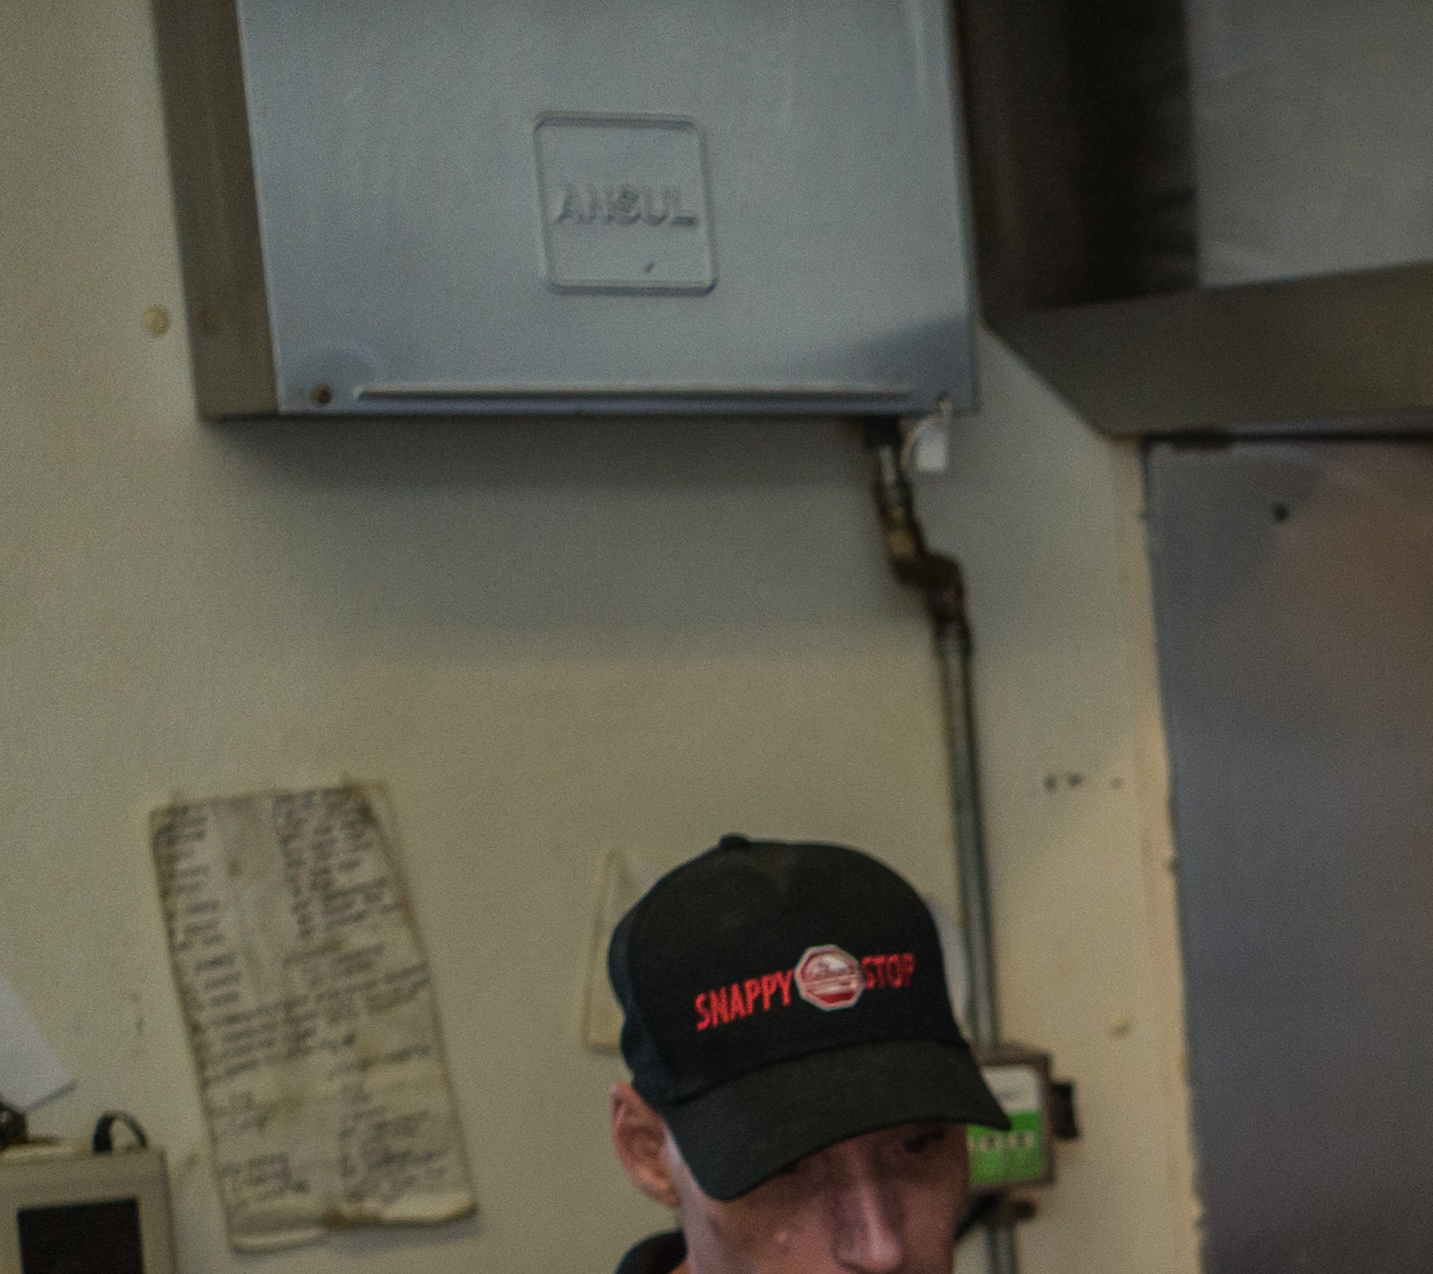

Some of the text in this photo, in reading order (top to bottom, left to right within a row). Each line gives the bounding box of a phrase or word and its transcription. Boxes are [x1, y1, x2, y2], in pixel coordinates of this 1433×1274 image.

[553, 182, 698, 228] ANSUL
[694, 952, 915, 1031] SNAPPY STOP
